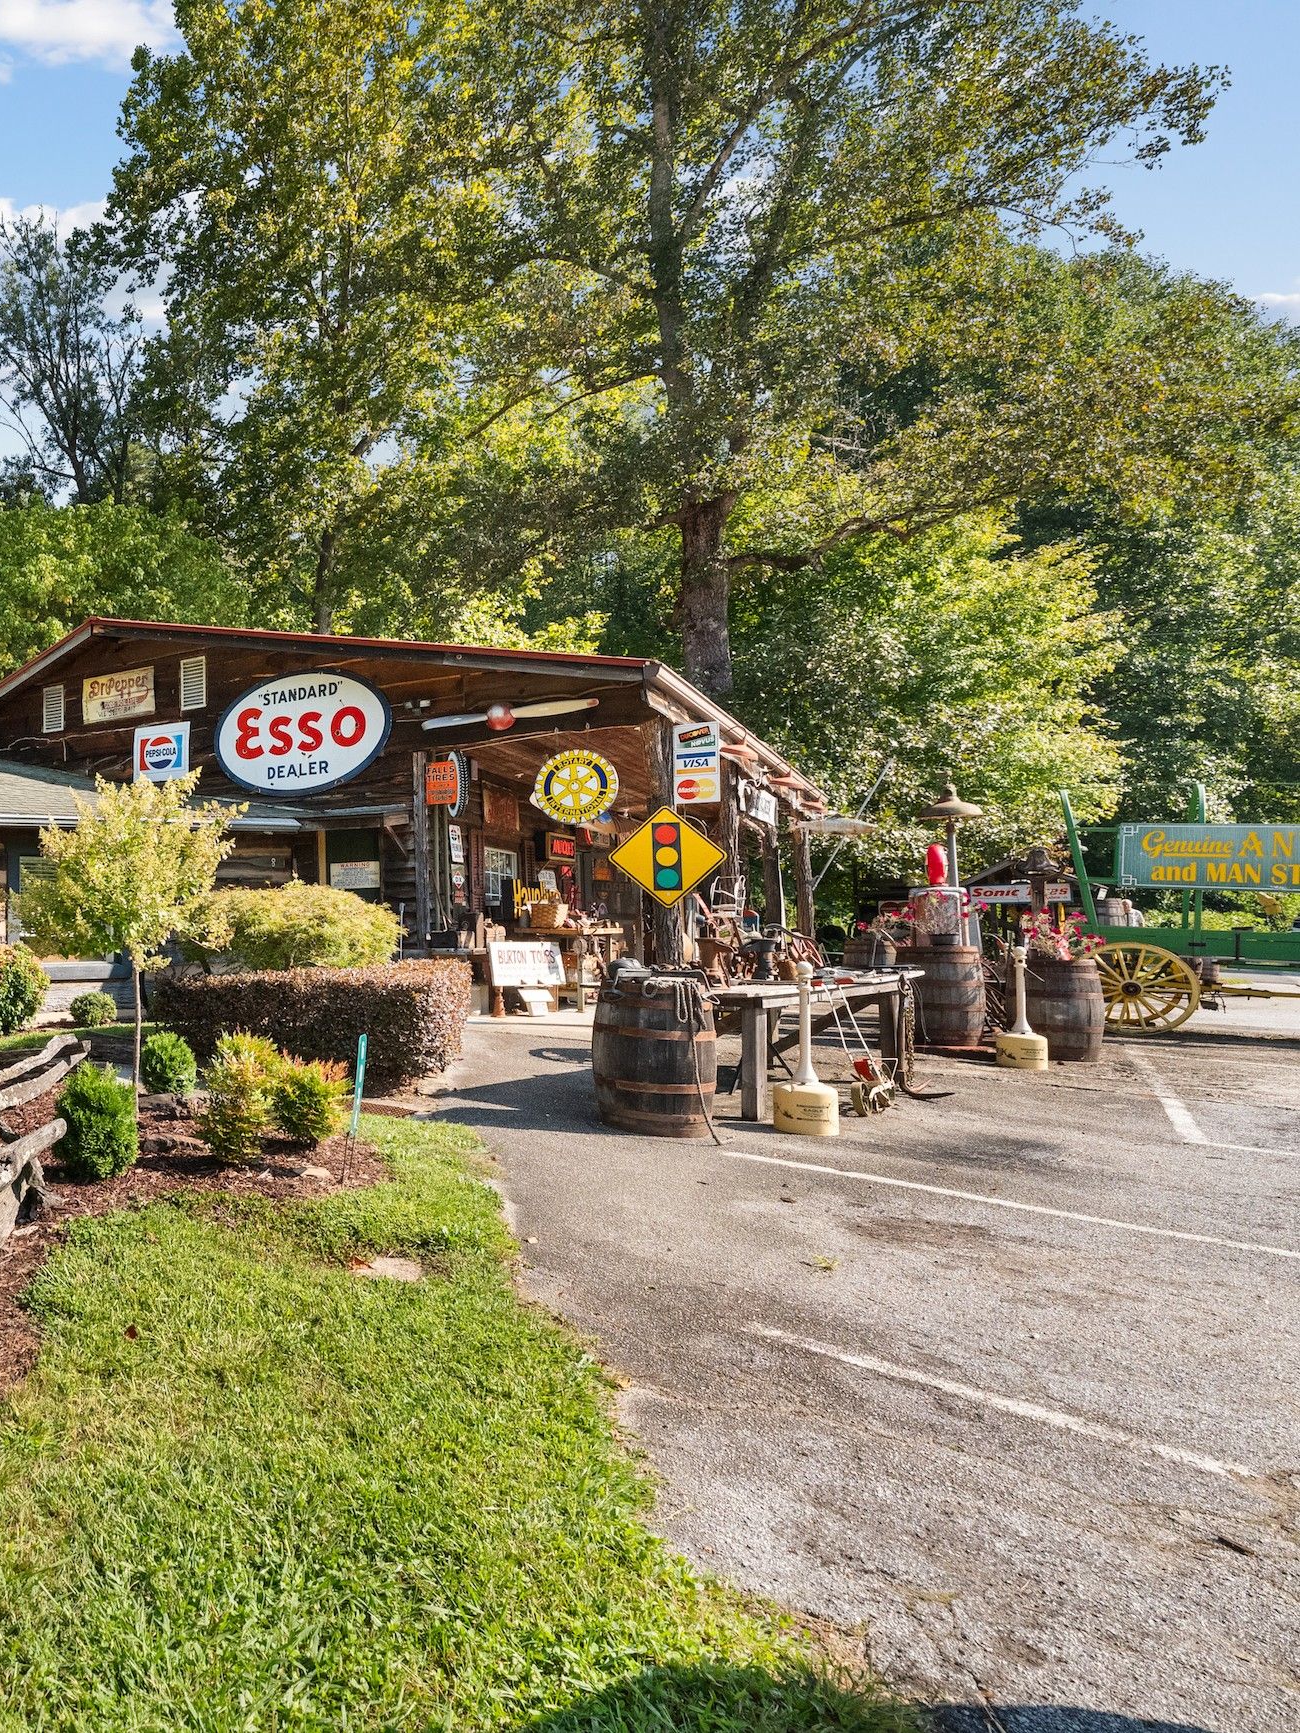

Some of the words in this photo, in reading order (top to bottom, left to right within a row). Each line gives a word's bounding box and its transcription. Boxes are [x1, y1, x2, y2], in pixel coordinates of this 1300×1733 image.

[427, 765, 455, 774] FALLS
[557, 757, 591, 769] ROTARY
[683, 759, 709, 768] VISA
[267, 760, 329, 780] DEALER
[427, 773, 455, 782] TIRES
[547, 793, 607, 816] INTERNATIONAL
[1141, 830, 1234, 859] Genuine
[1151, 862, 1197, 882] and
[1206, 862, 1262, 884] MAN
[971, 887, 1020, 898] Sonic
[1026, 885, 1069, 898] Tes
